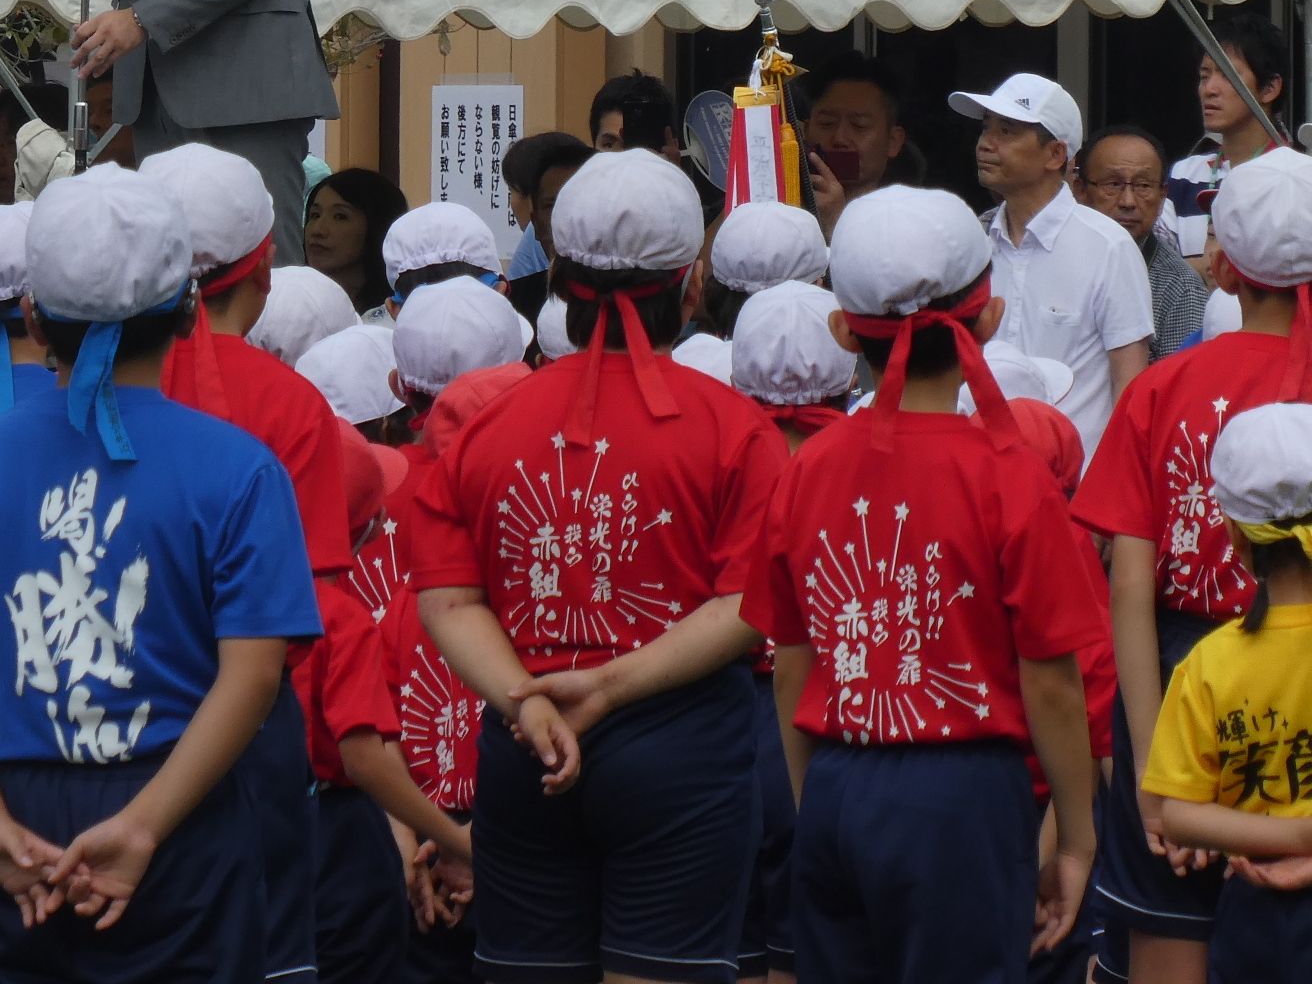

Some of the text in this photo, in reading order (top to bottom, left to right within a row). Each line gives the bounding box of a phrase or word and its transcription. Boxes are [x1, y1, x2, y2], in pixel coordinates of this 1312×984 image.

[457, 105, 467, 174] 後方にて
[491, 104, 500, 209] 観覧の妨げに
[564, 524, 583, 567] 我ら
[589, 493, 613, 603] 栄光の扉
[871, 598, 889, 648] 我ら
[896, 565, 921, 686] 栄光の扉
[1216, 708, 1278, 745] 輝け
